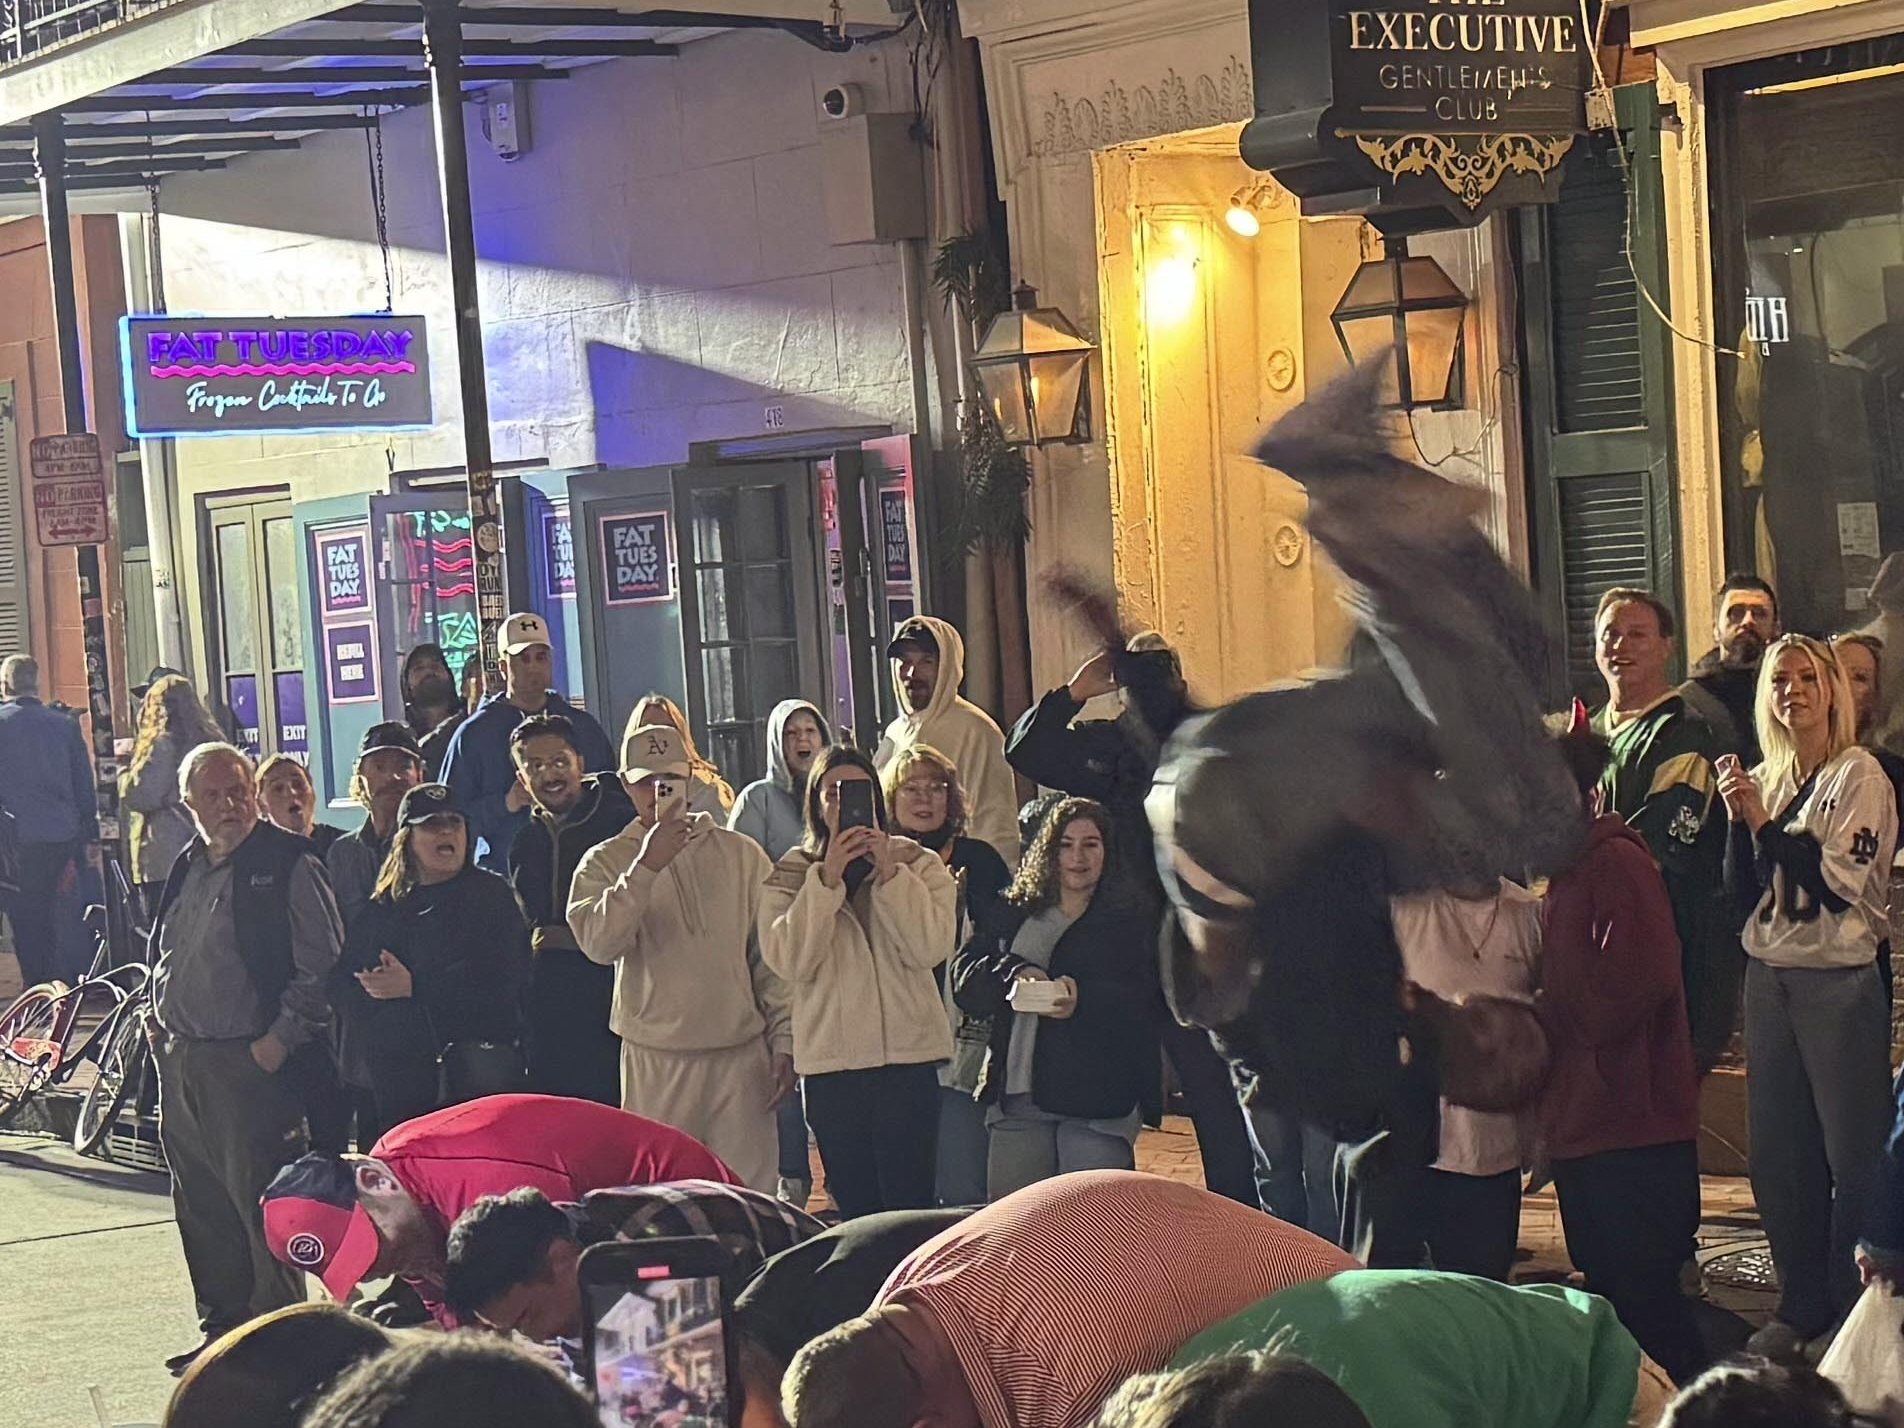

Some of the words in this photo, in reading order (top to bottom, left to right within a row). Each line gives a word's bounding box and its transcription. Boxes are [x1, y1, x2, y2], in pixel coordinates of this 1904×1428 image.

[1348, 11, 1577, 53] EXECUTIVE
[1379, 64, 1552, 90] GENTLEMEN'S
[1435, 96, 1498, 121] CLUB
[148, 331, 222, 362] FAT
[228, 329, 413, 361] TUESDAY
[186, 380, 252, 418] Frozen
[258, 376, 338, 412] Cocktails
[337, 380, 364, 407] To
[363, 378, 386, 409] Go
[885, 500, 903, 521] FAT
[613, 524, 655, 548] FAT
[327, 544, 357, 565] FAT
[615, 546, 658, 566] TUES
[888, 543, 906, 562] DAY
[329, 561, 360, 581] TUES
[617, 565, 658, 584] DAY
[330, 579, 360, 599] DAY
[283, 725, 306, 740] EXIT
